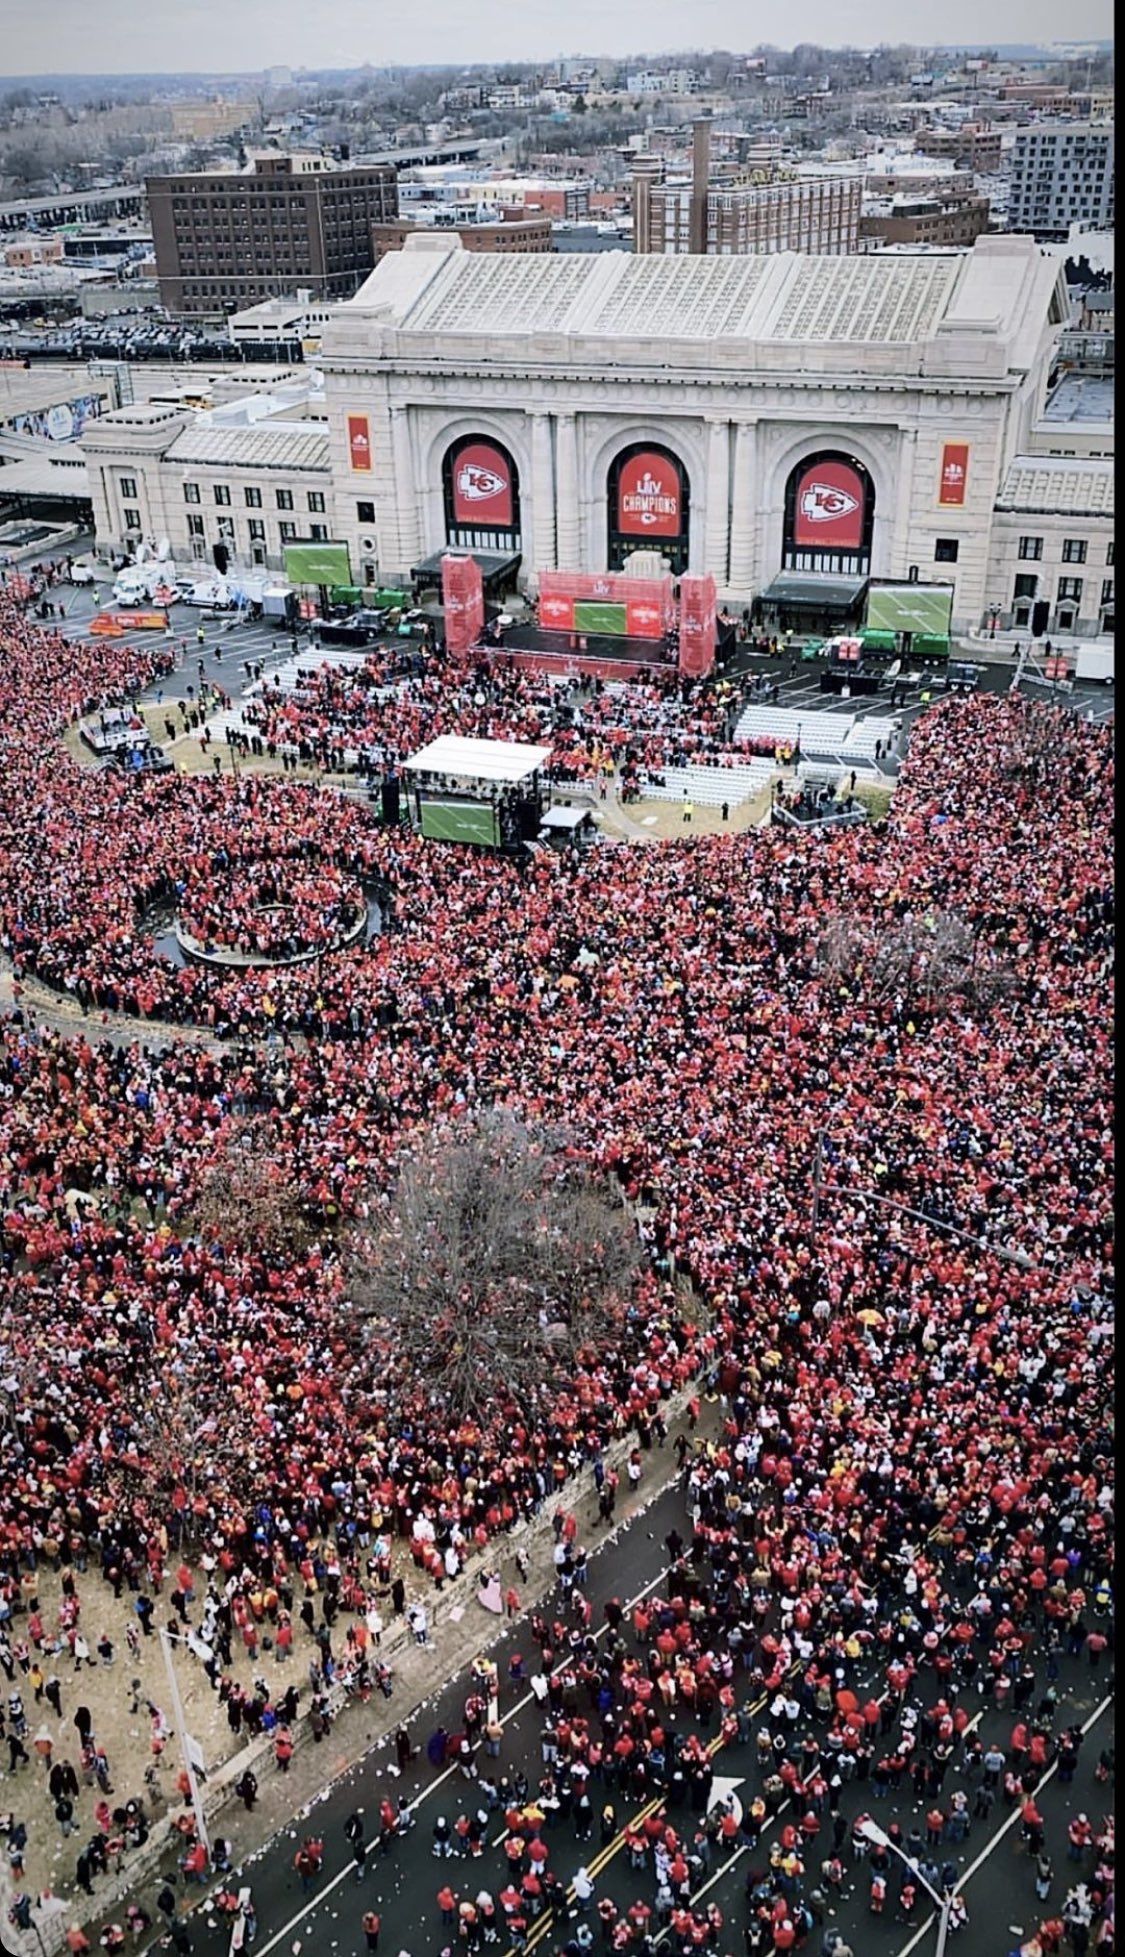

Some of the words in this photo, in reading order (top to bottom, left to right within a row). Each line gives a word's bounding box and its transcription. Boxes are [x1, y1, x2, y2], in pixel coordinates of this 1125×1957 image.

[469, 473, 495, 493] KC
[623, 495, 677, 515] CHAMPIONS
[815, 492, 845, 514] KC
